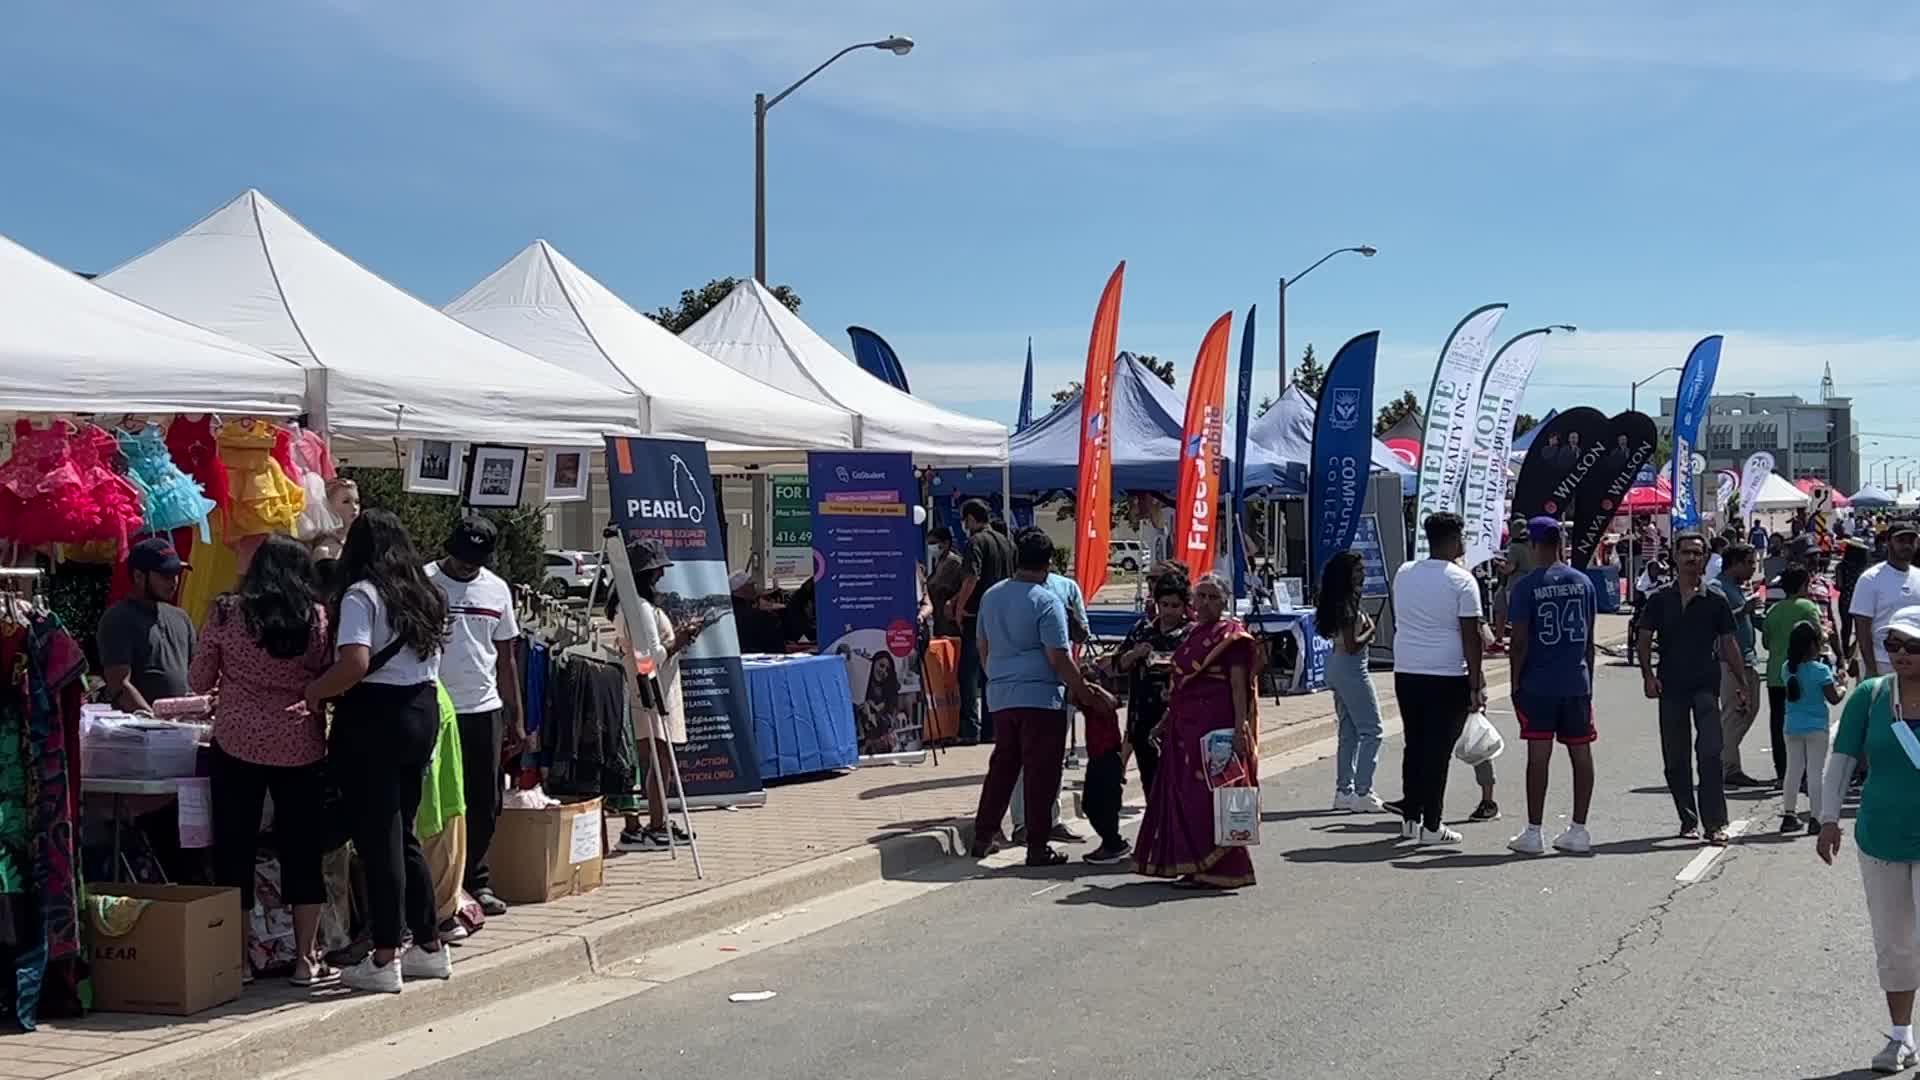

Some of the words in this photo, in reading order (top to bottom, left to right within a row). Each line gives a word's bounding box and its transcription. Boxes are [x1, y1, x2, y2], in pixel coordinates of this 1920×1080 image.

[1443, 420, 1463, 485] REALTY
[1553, 441, 1606, 499] WILSON
[1608, 441, 1652, 496] WILSON
[627, 499, 689, 518] PEARL
[776, 486, 802, 499] FOR
[1333, 456, 1356, 547] COMPUTEK
[1533, 584, 1585, 601] MATTHEWS
[1538, 599, 1585, 645] 34
